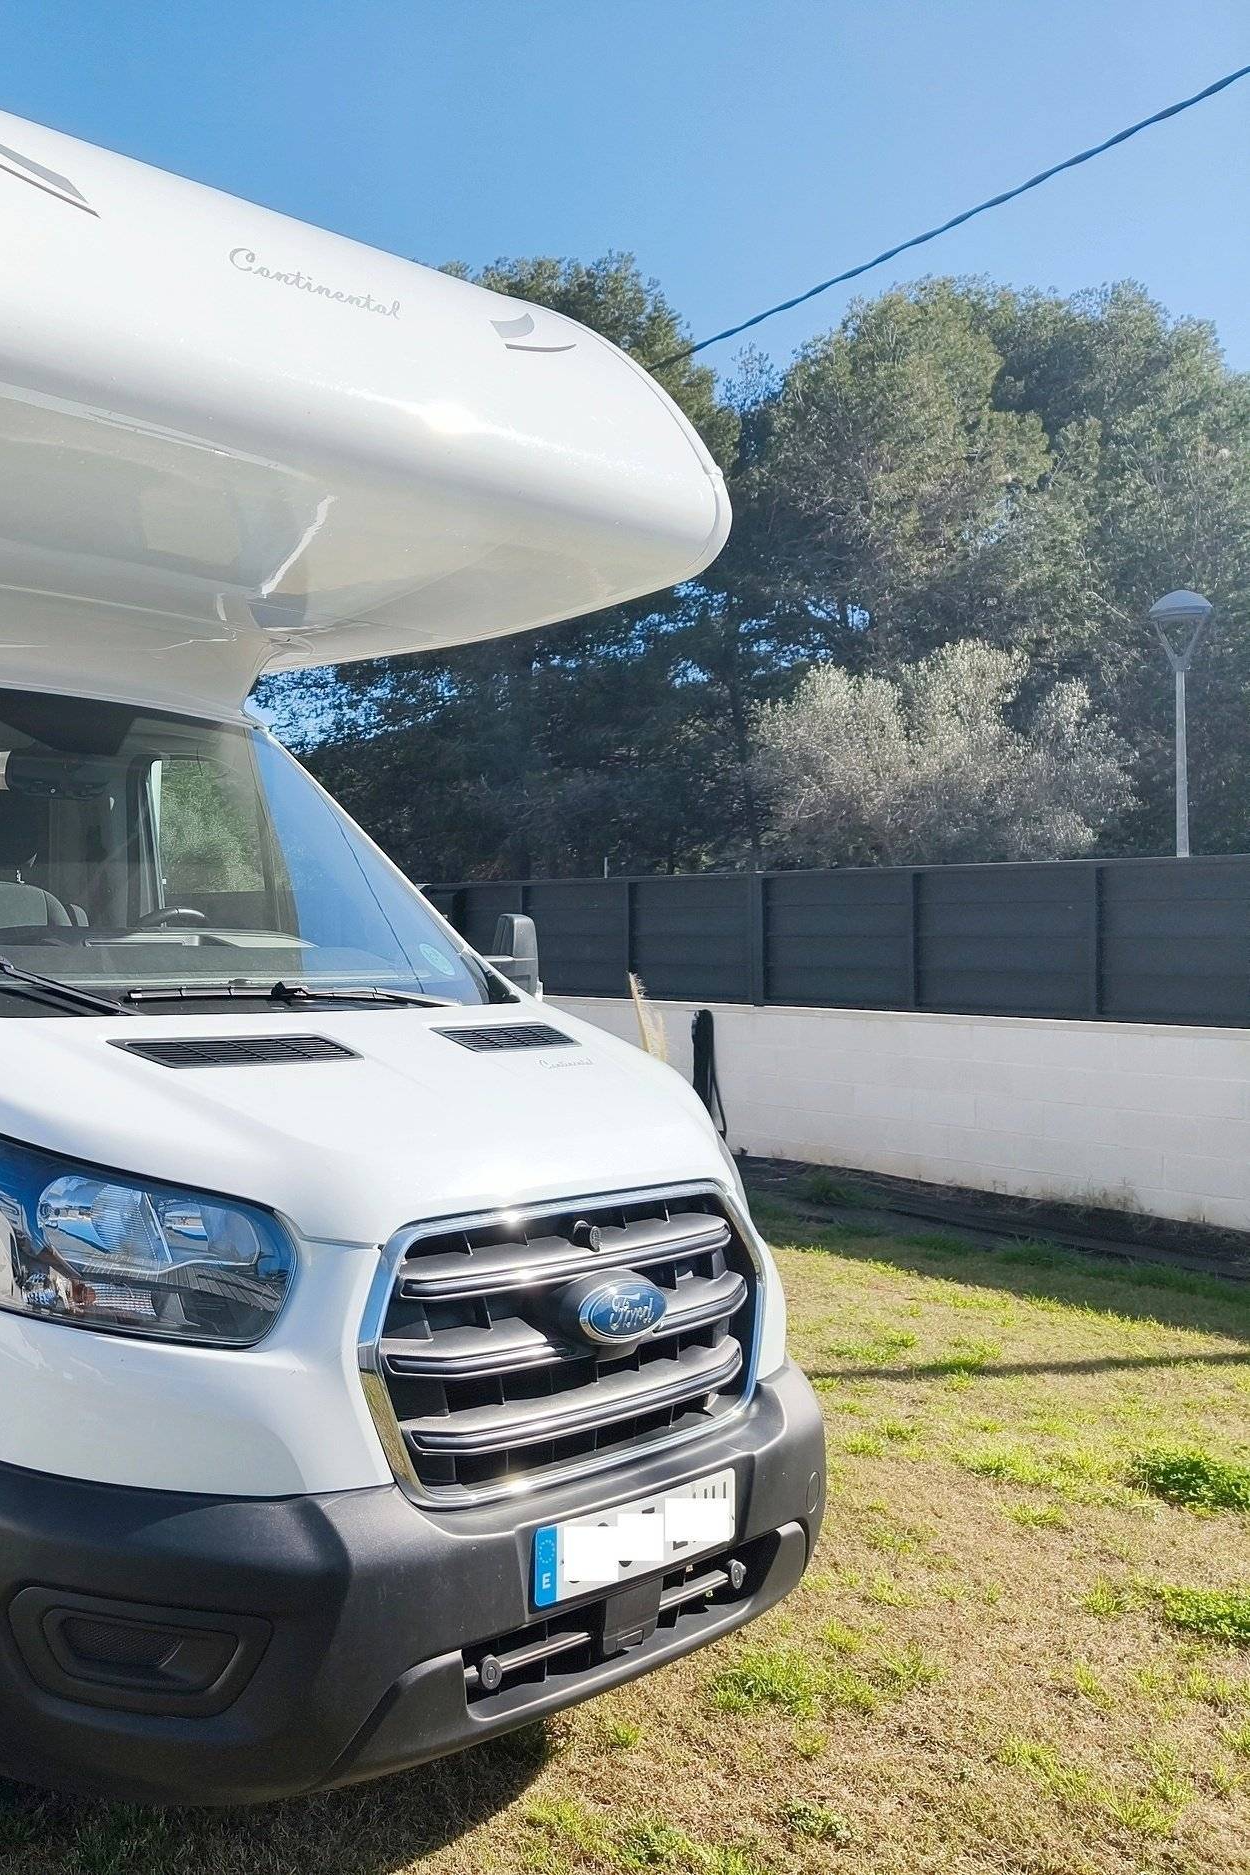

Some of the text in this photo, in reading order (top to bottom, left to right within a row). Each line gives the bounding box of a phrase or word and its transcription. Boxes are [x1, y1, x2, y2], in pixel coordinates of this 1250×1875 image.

[229, 247, 400, 320] Continental
[609, 1292, 655, 1331] Ford
[541, 1572, 551, 1590] E
